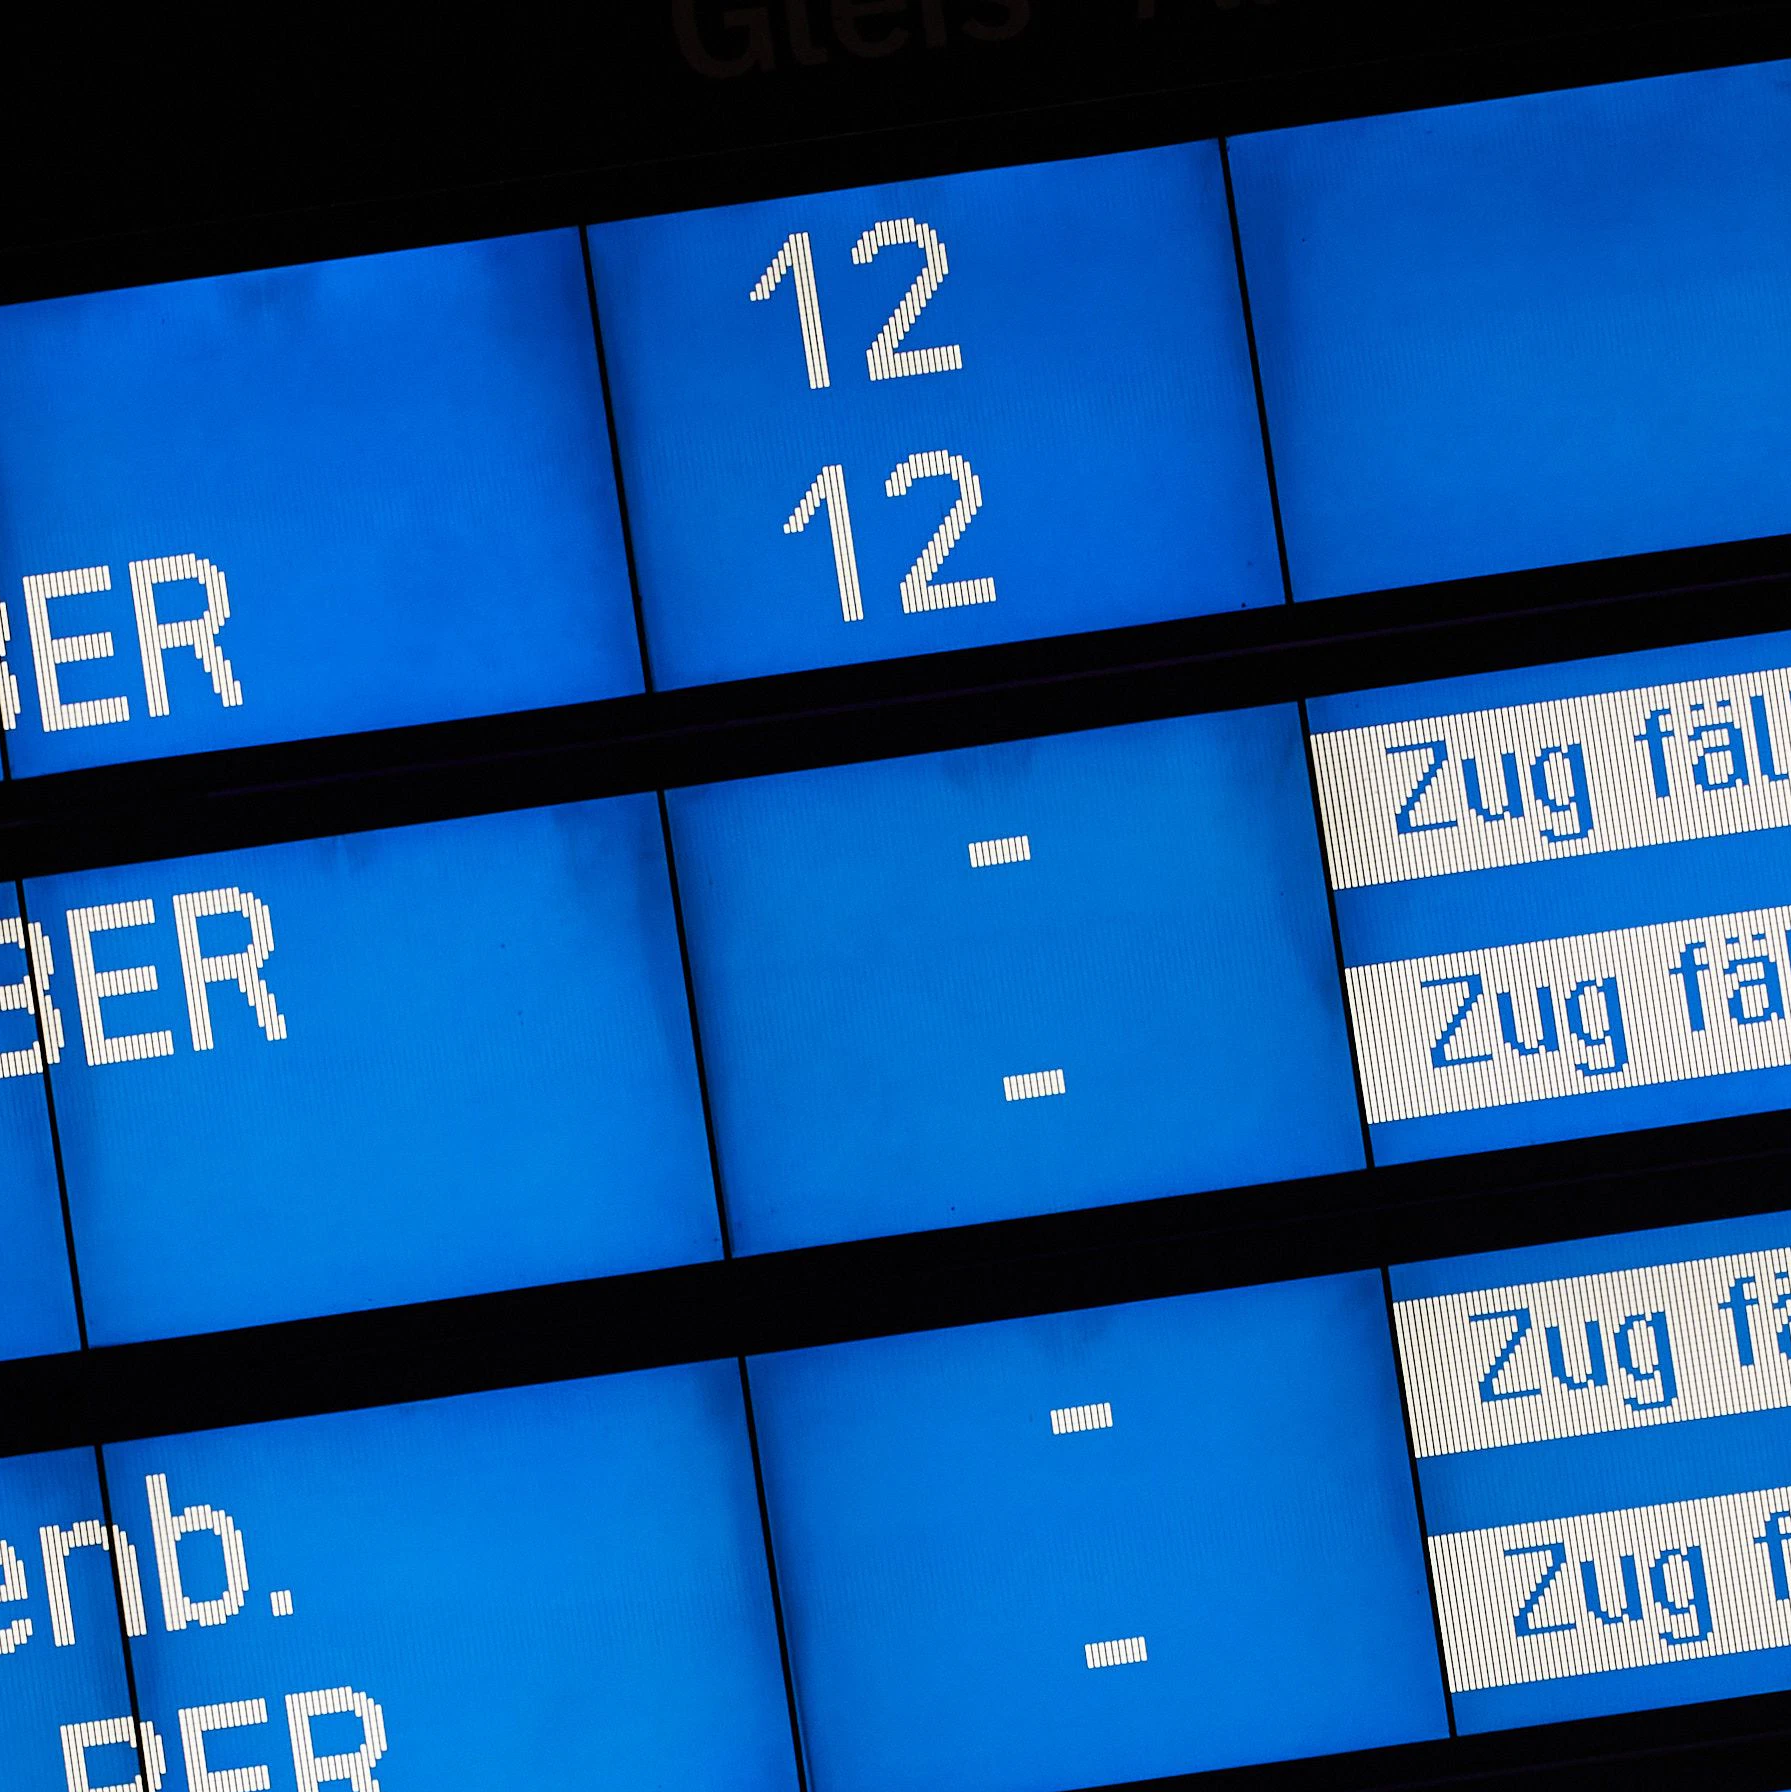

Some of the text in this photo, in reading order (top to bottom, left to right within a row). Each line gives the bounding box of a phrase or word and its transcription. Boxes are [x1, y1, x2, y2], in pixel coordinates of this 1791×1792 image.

[748, 216, 964, 391] 12
[782, 448, 998, 623] 12
[1385, 738, 1596, 845] Zug
[1419, 972, 1631, 1079] Zug
[1467, 1306, 1680, 1413] Zug
[1504, 1540, 1715, 1648] Zug
